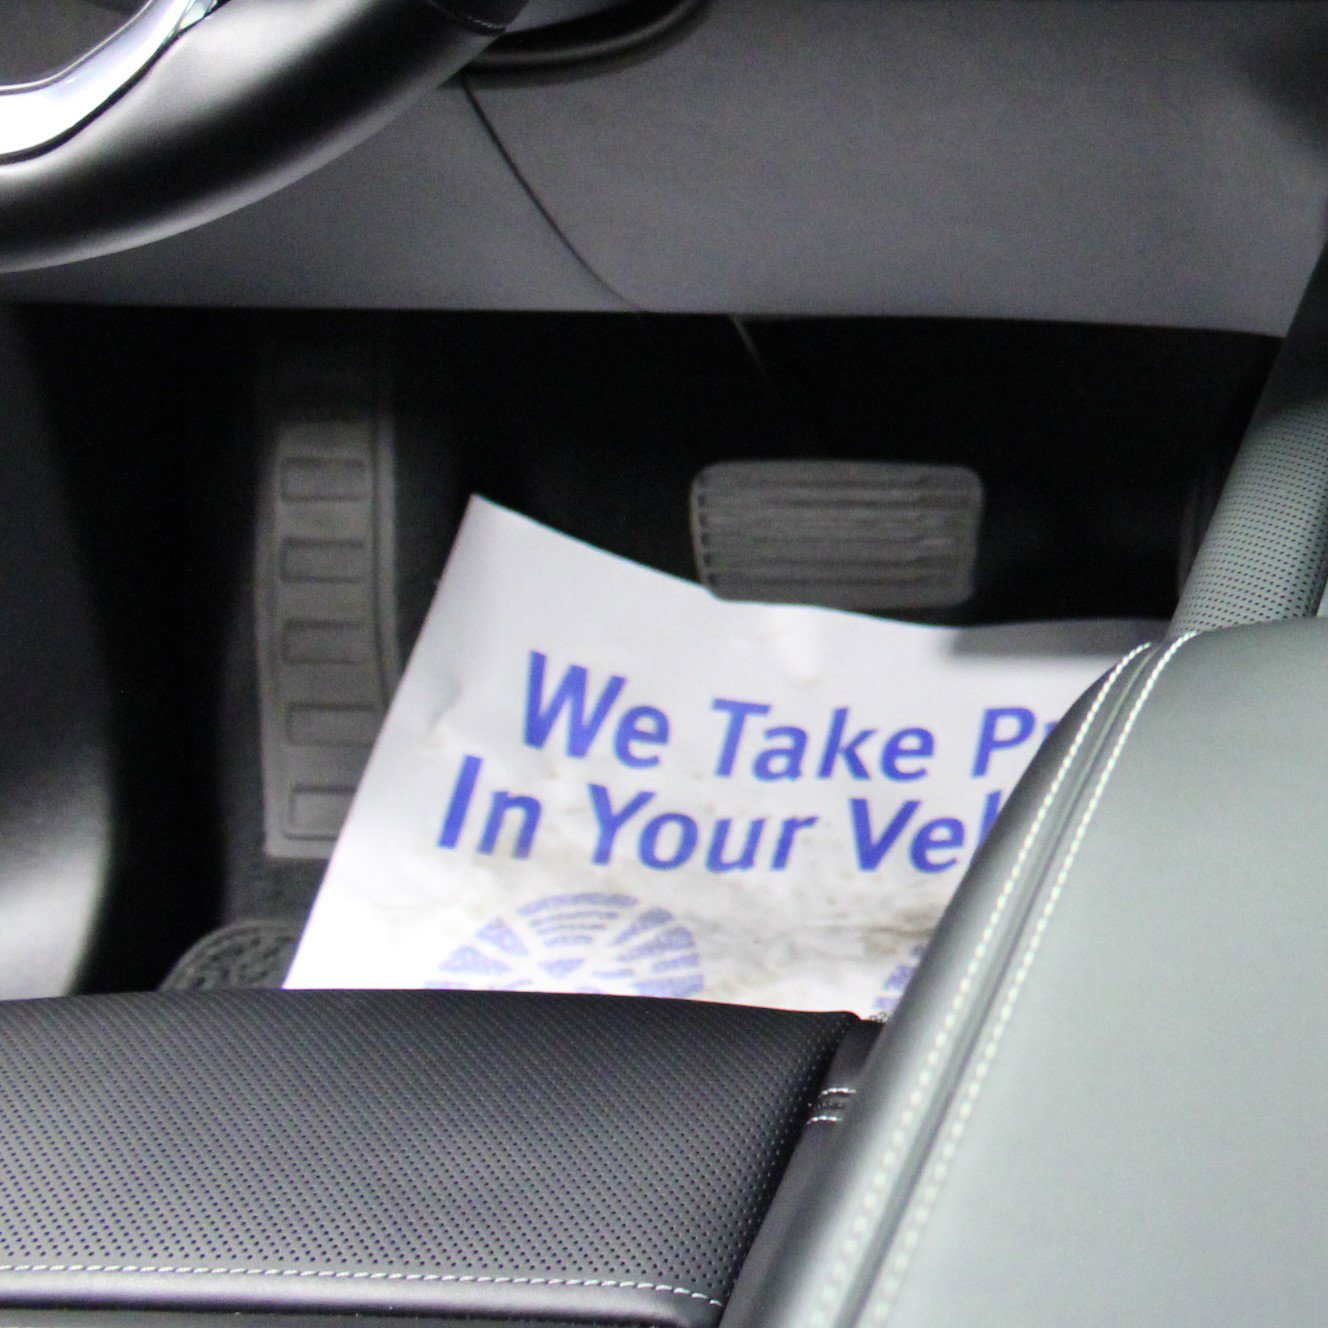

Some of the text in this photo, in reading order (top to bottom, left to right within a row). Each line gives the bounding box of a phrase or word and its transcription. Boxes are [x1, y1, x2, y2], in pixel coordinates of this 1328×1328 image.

[523, 651, 671, 770] We
[711, 698, 935, 784] Take
[437, 755, 543, 859] In
[588, 784, 817, 873] Your
